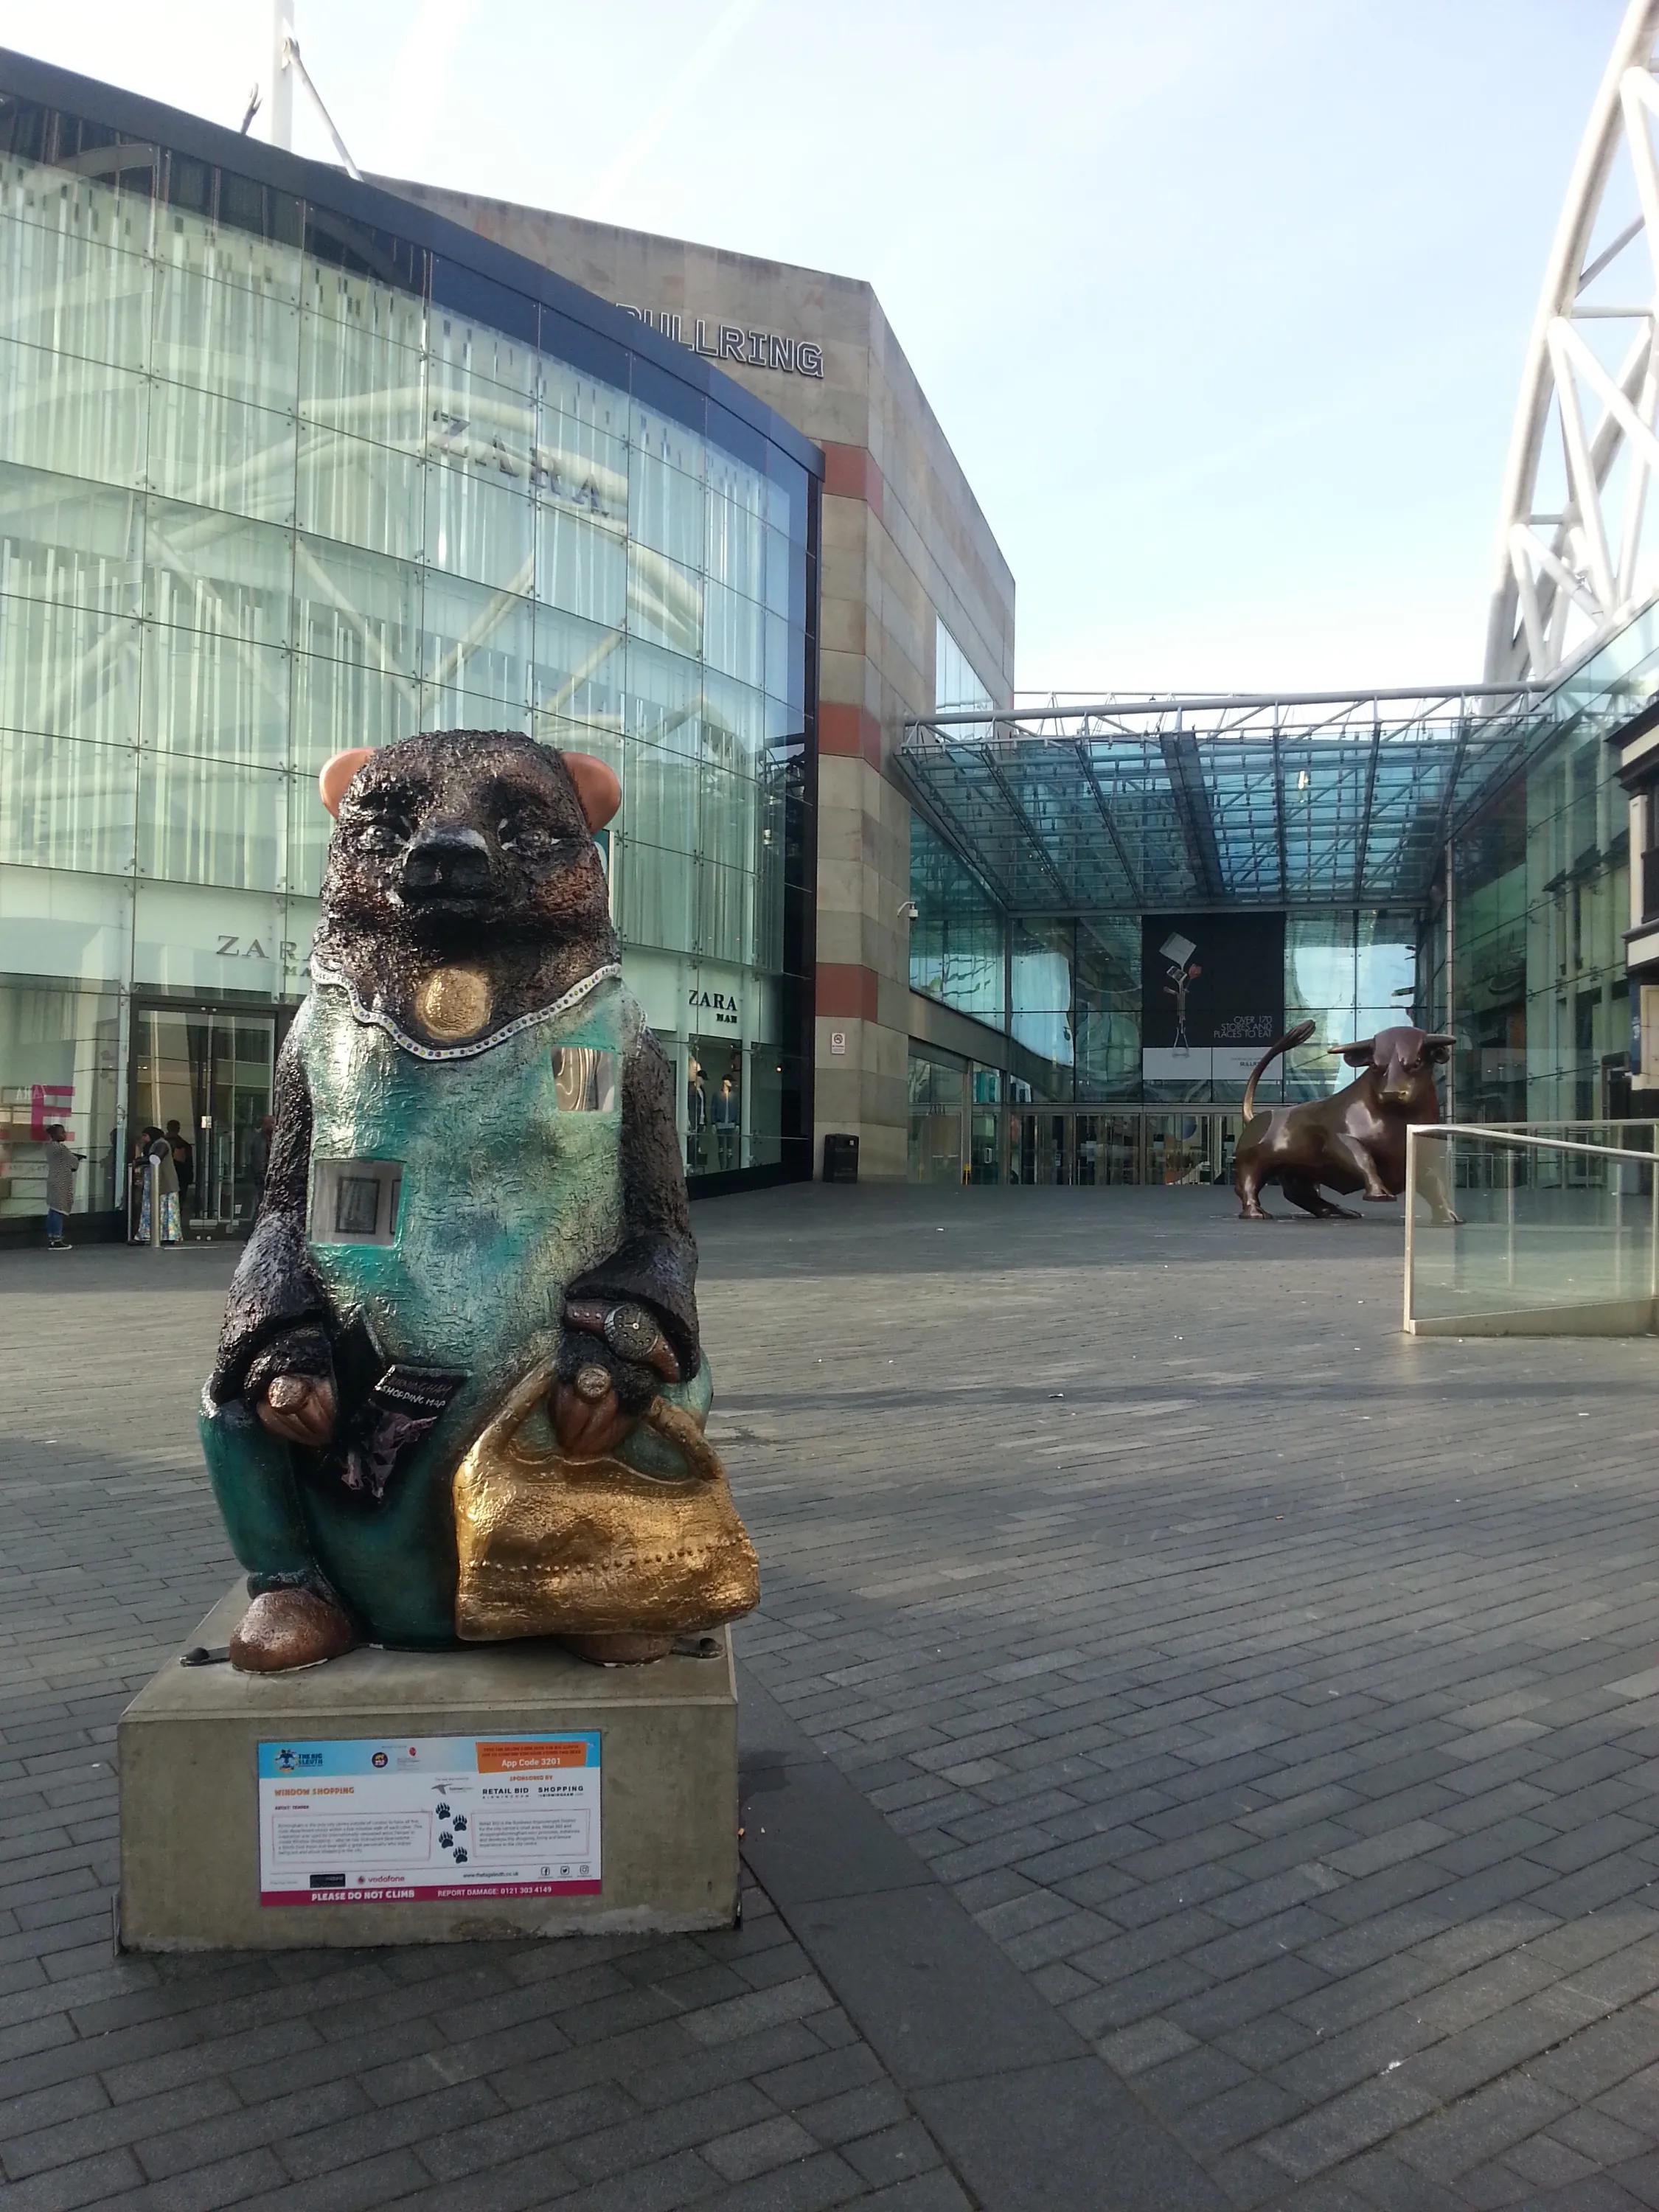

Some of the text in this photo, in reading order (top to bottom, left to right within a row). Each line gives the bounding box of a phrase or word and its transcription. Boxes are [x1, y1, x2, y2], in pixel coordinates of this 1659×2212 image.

[283, 965, 312, 977] MA
[689, 990, 738, 1011] ZARA
[716, 1013, 738, 1023] MAN
[1234, 1015, 1255, 1023] OVER
[1221, 1023, 1251, 1031] STORES
[1214, 1030, 1242, 1038] PLACES
[1258, 1030, 1273, 1038] EAT
[381, 1385, 446, 1408] SHOPPING MAP
[501, 1759, 517, 1768] App
[274, 1787, 355, 1797] WINDOW SHOPPING
[538, 1785, 584, 1793] SHOPPING
[367, 1875, 405, 1883] vodafone
[311, 1890, 415, 1902] PLEASE DO NOT CLIMB
[437, 1889, 465, 1897] REPORT
[467, 1888, 499, 1896] DAMAGE:
[501, 1887, 518, 1895] 0121
[533, 1886, 552, 1894] 4149
